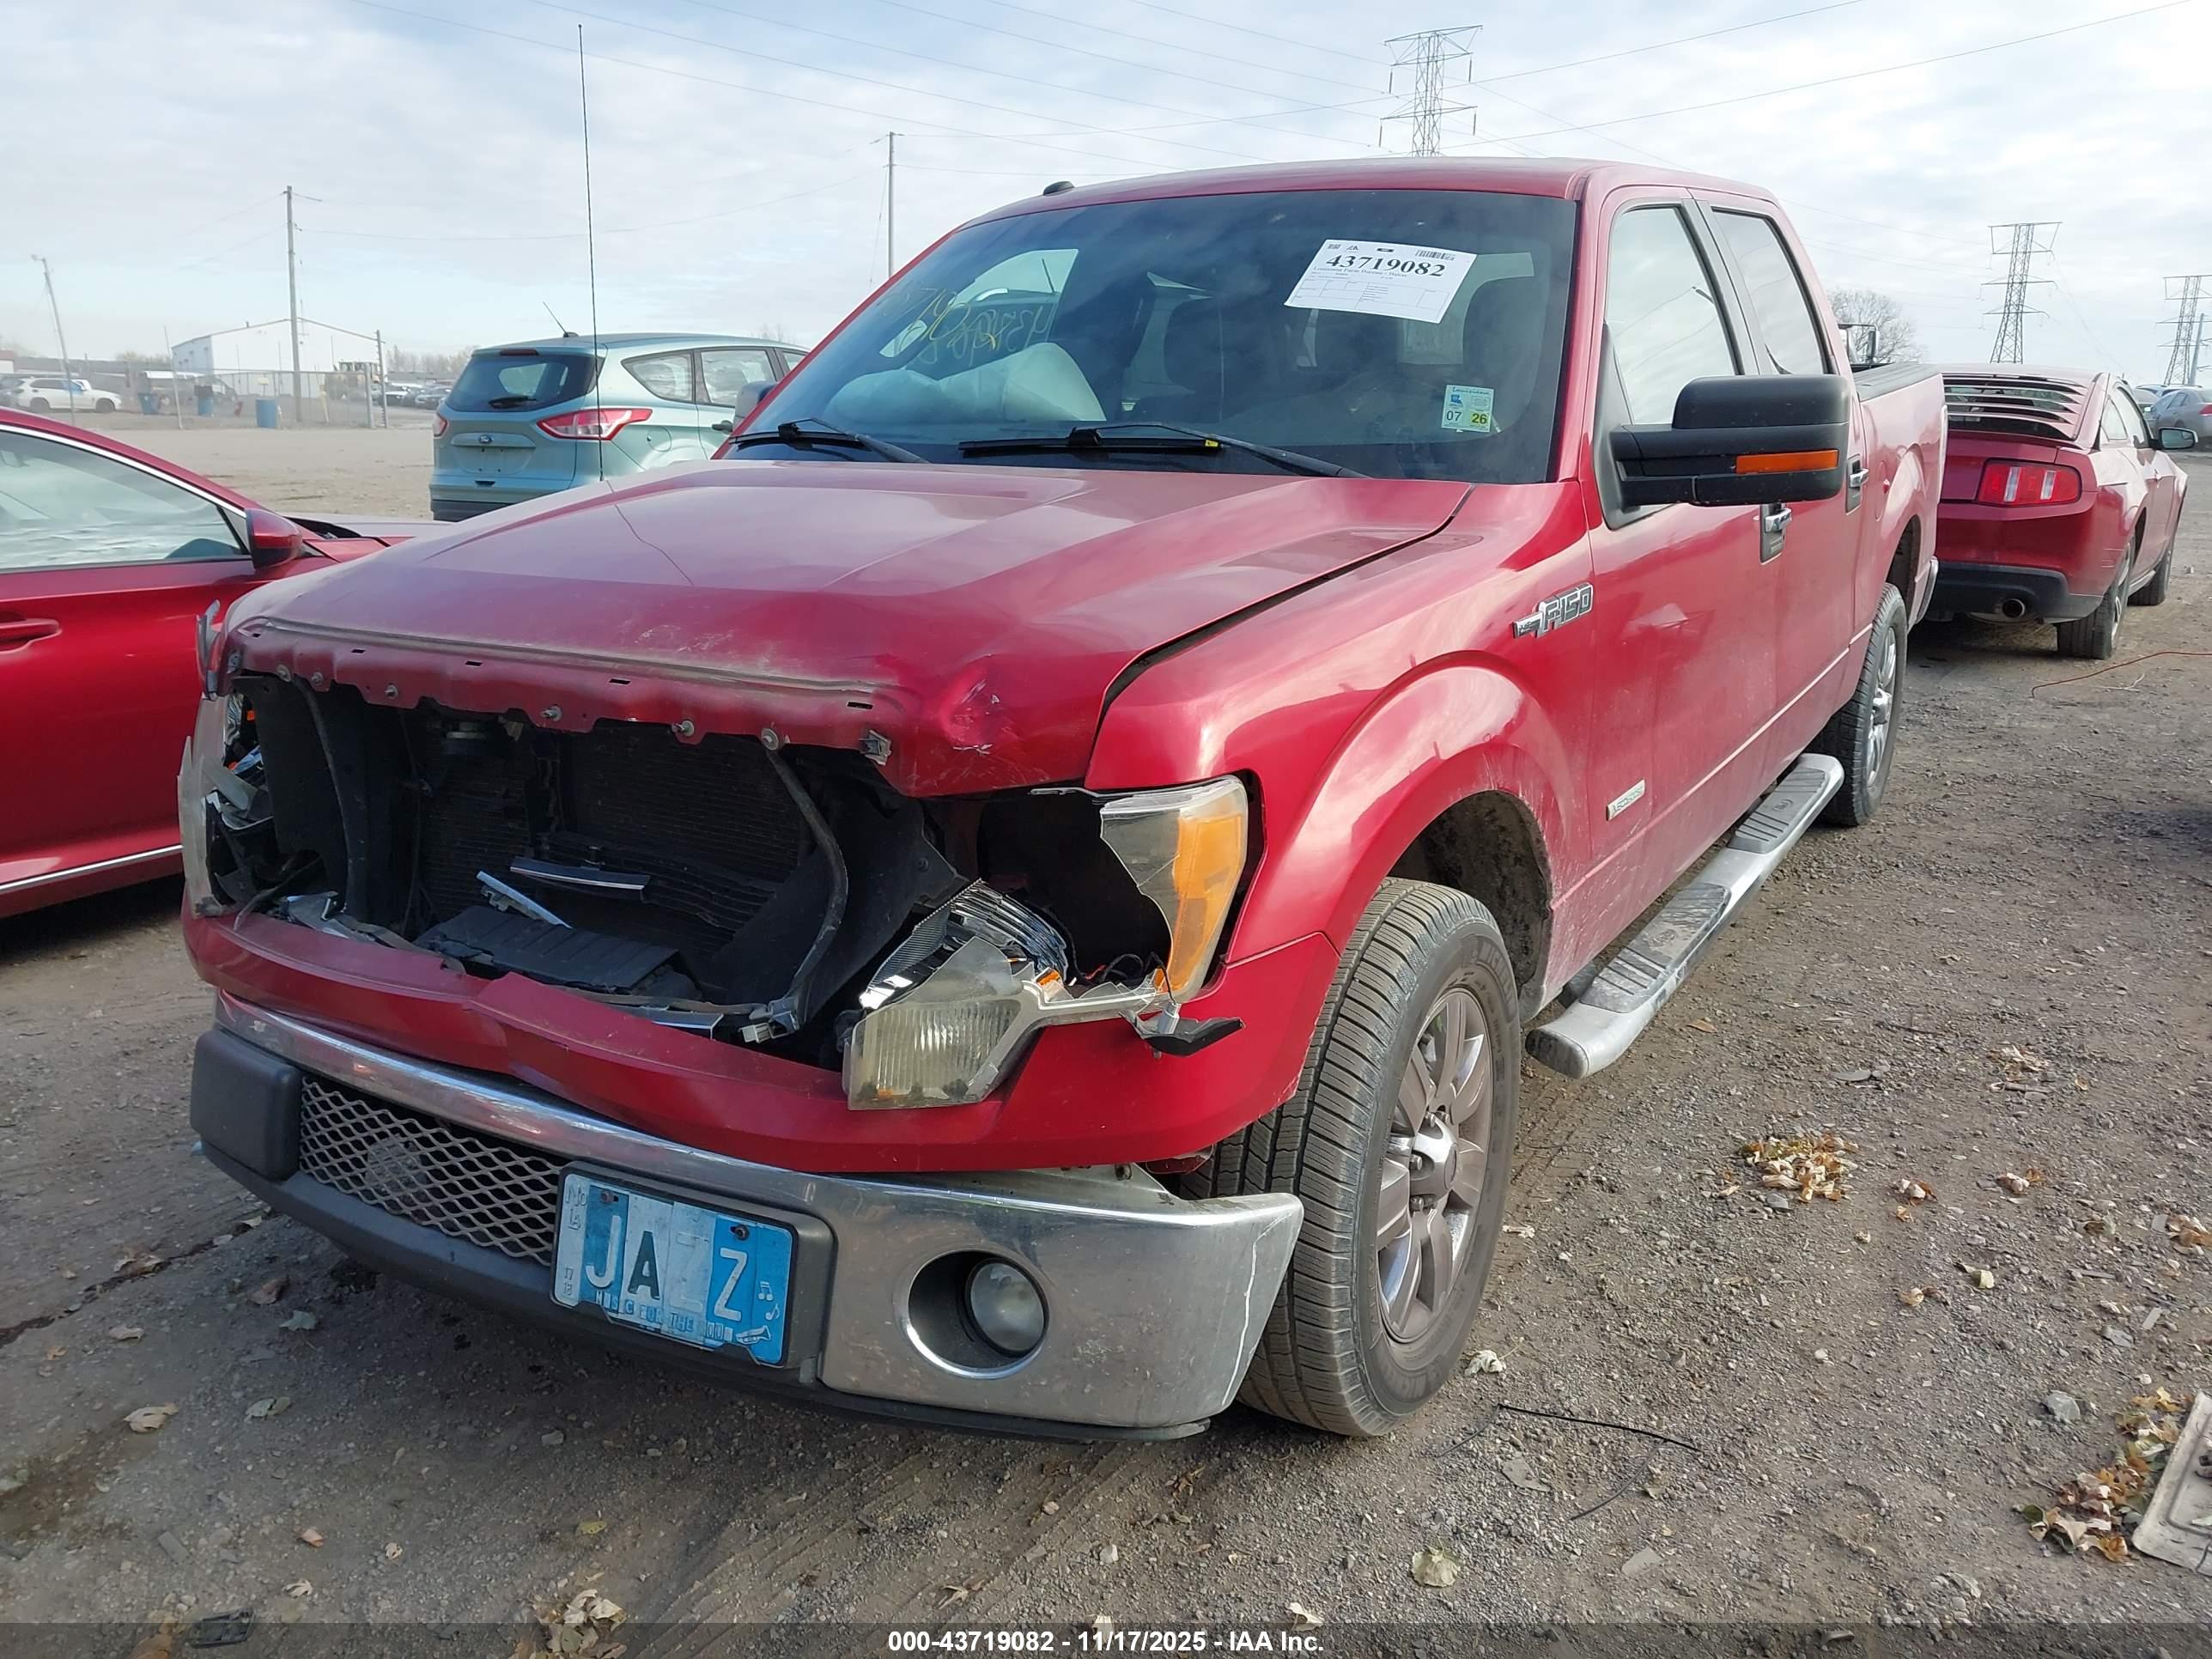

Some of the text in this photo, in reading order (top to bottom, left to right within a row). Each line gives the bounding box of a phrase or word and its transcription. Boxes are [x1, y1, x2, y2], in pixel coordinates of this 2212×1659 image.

[1325, 254, 1446, 277] 43719082
[1446, 410, 1462, 422] 07
[1471, 413, 1487, 424] 26
